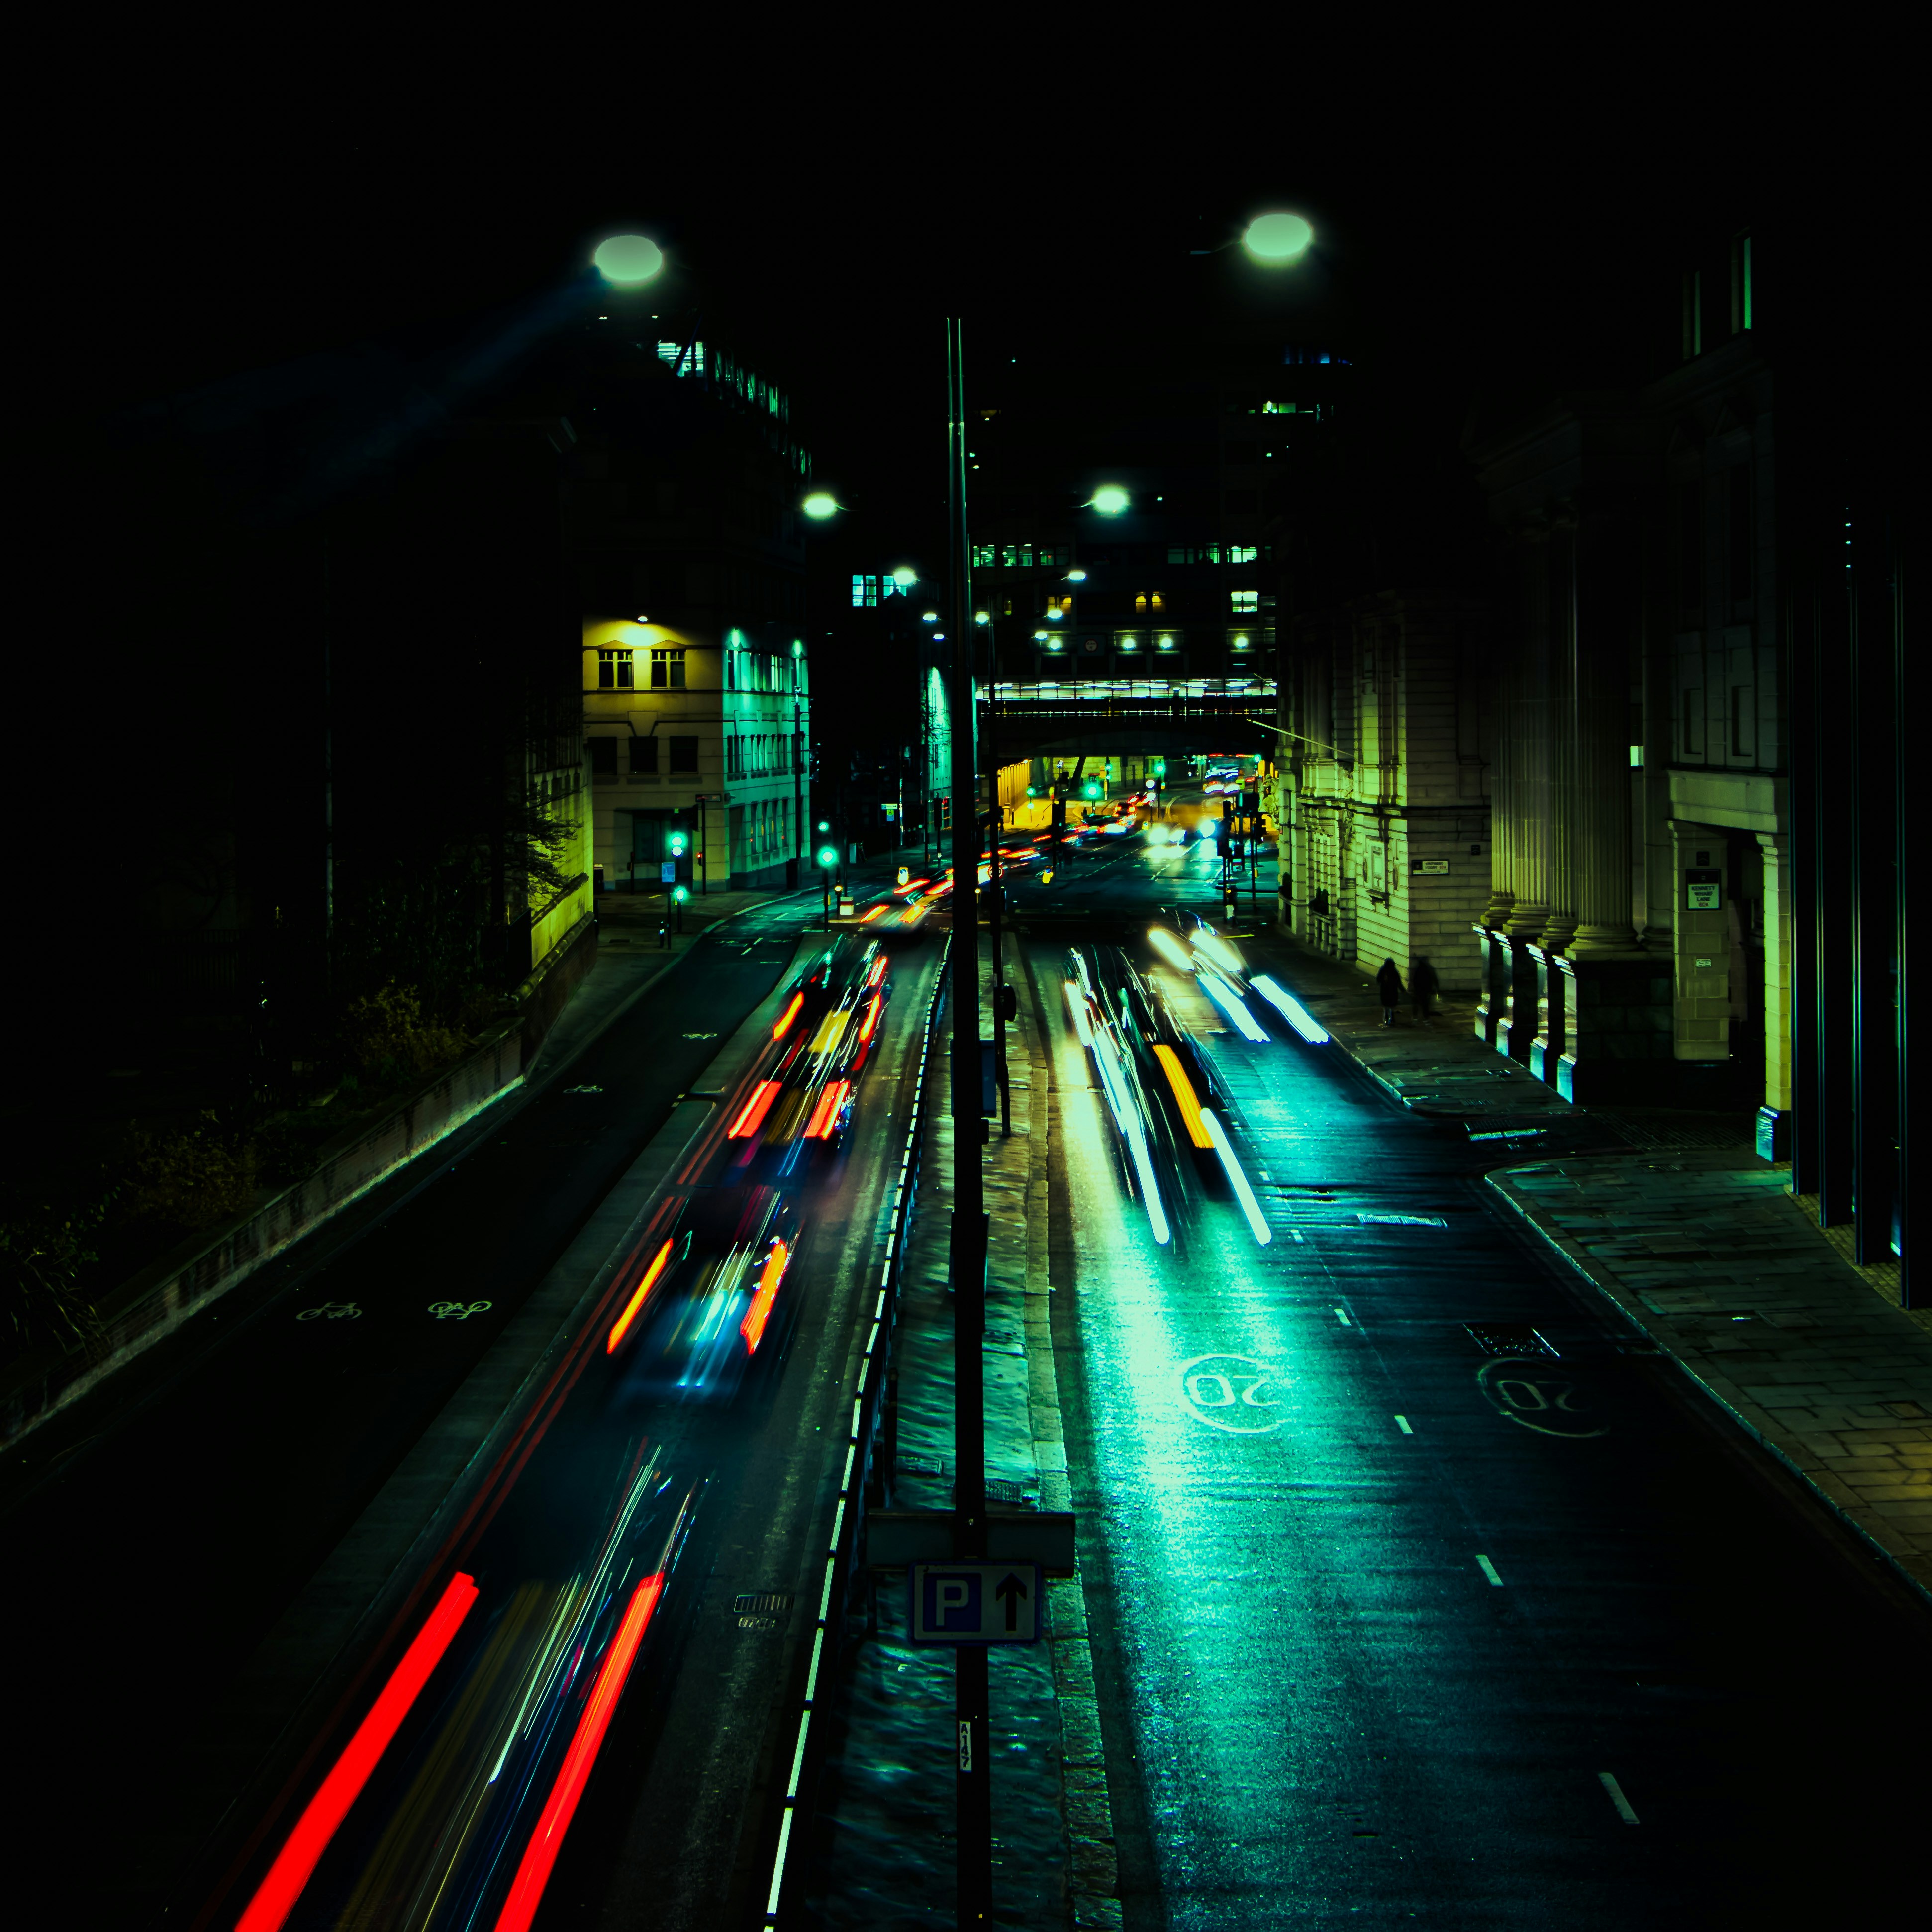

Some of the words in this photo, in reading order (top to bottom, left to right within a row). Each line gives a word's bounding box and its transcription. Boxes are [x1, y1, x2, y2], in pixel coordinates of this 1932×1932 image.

[1186, 1375, 1279, 1407] 20
[1497, 1379, 1588, 1412] 20
[935, 1579, 969, 1627] P
[961, 1723, 969, 1768] A147
